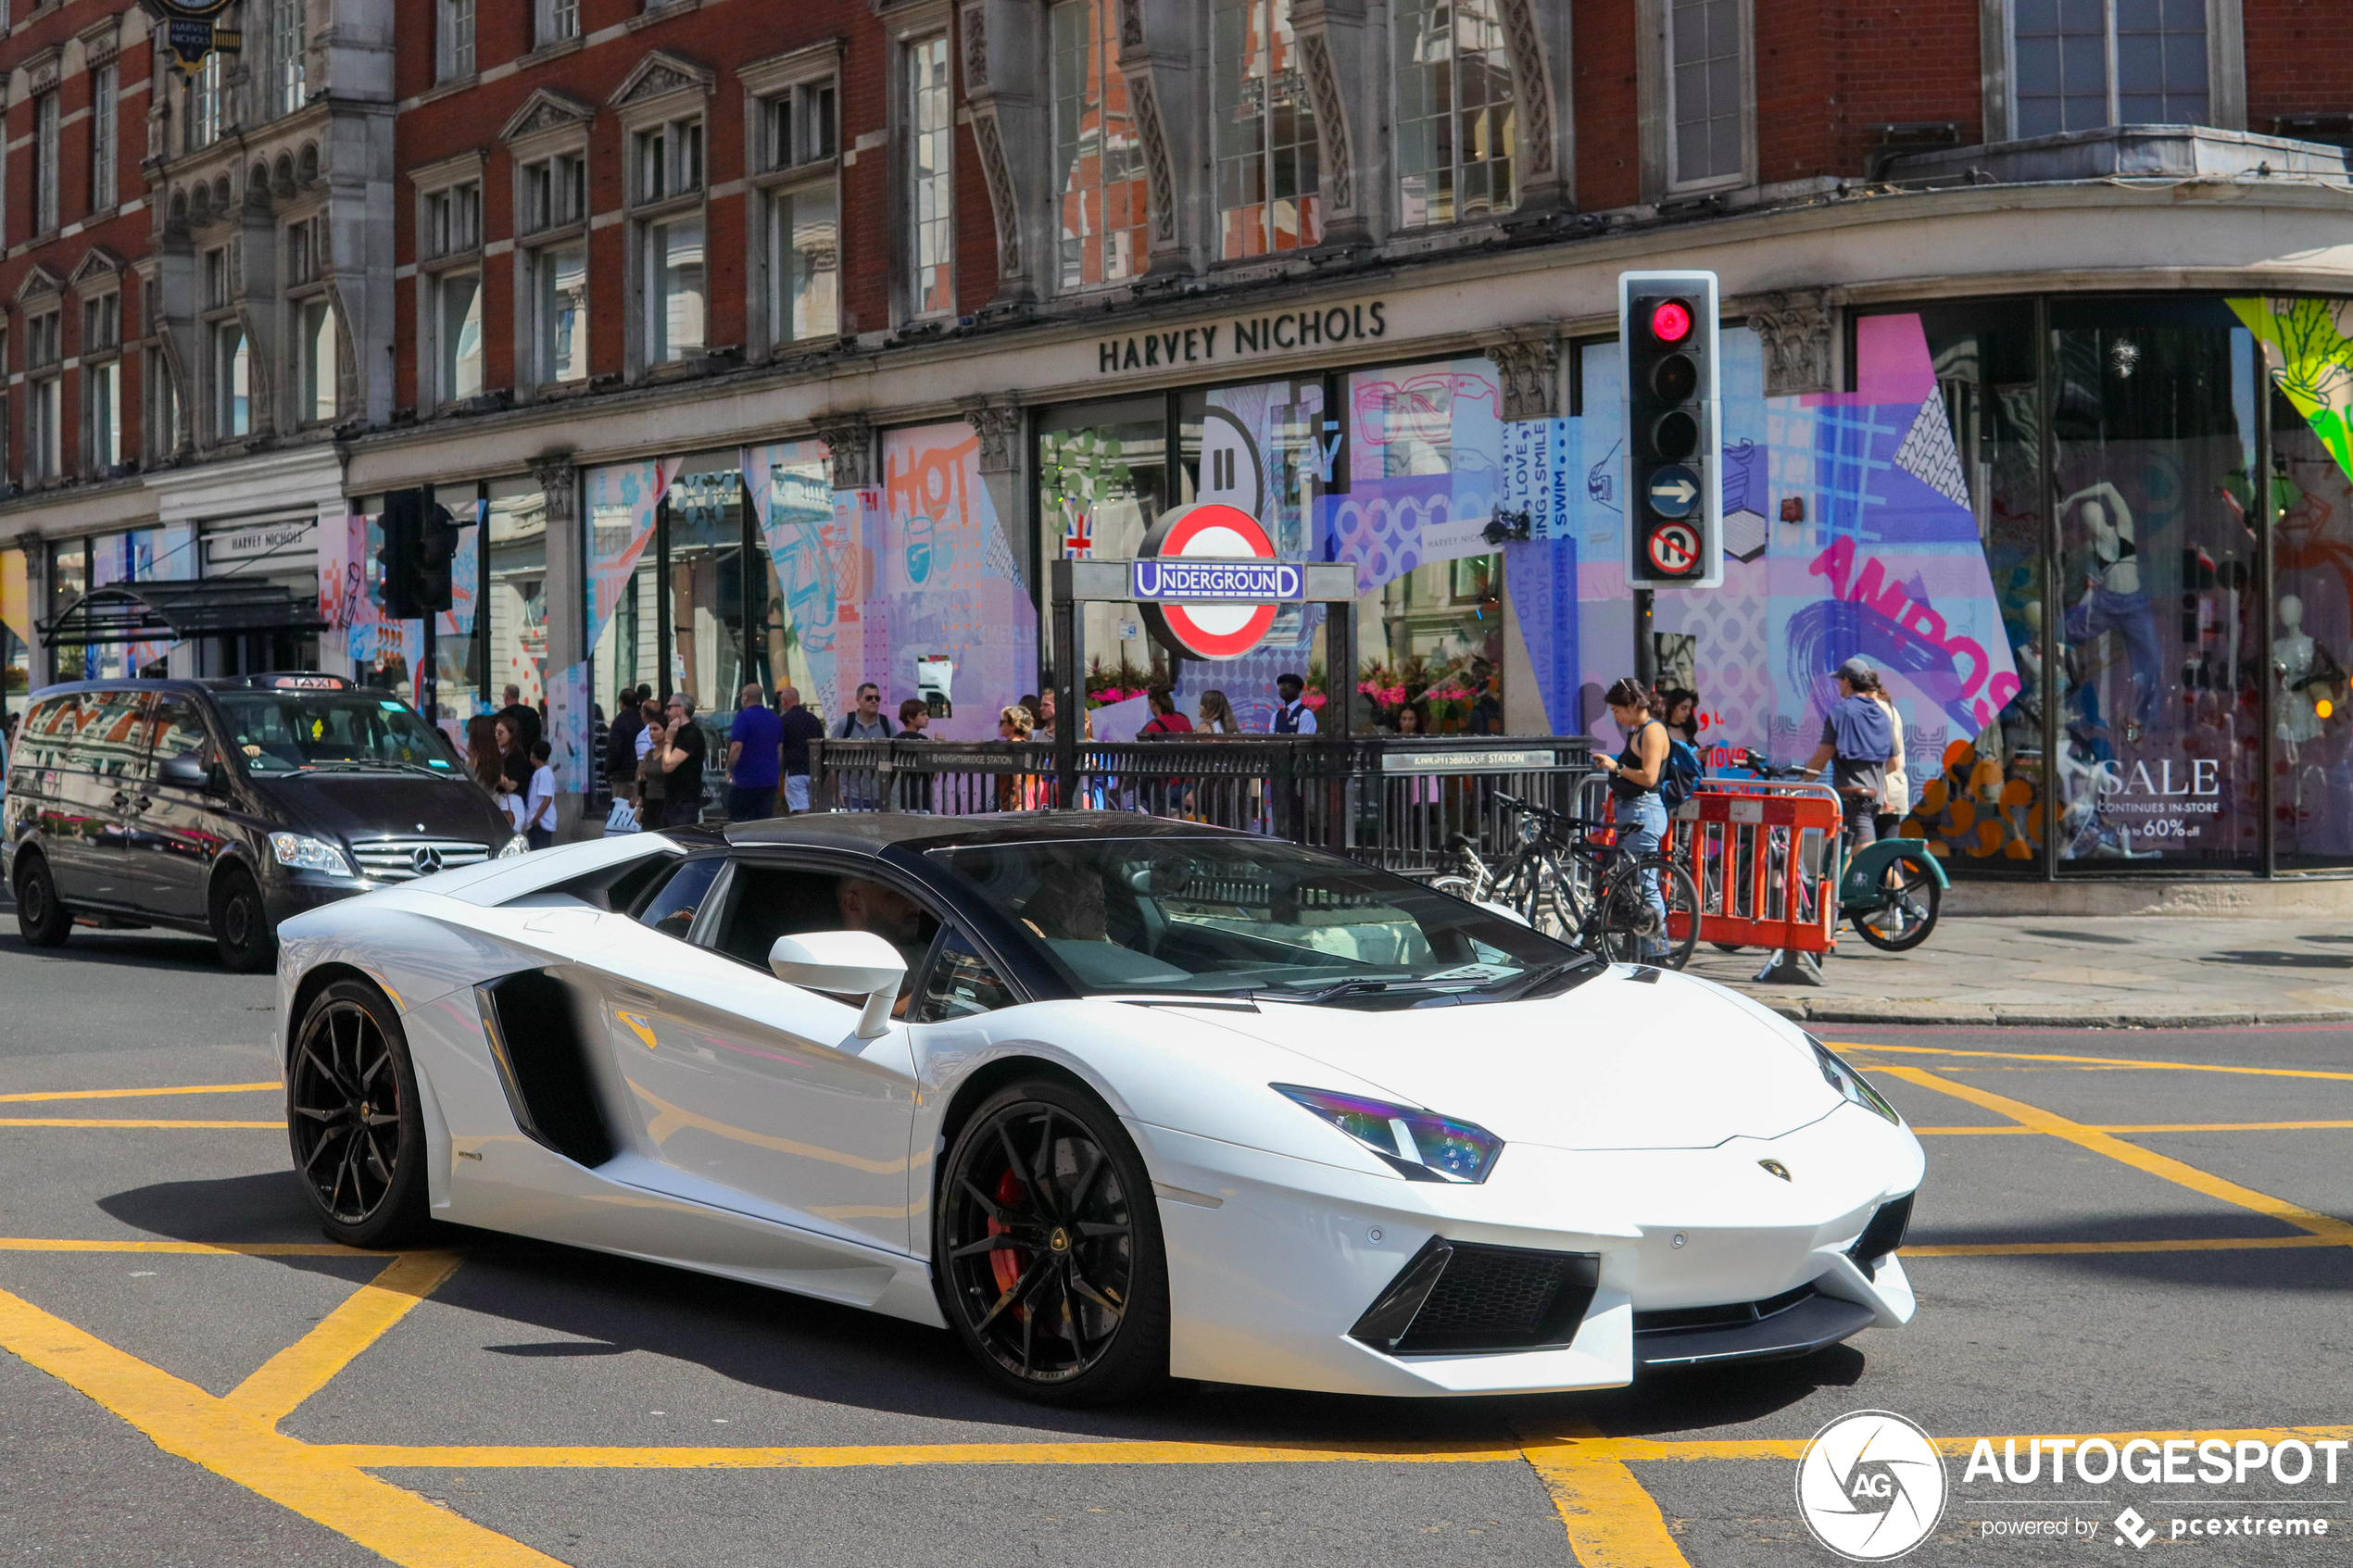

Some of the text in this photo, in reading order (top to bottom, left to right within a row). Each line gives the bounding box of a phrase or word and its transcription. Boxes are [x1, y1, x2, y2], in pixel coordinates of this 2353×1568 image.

[171, 22, 210, 33] HARVEY
[171, 33, 210, 44] NICHOLS
[1099, 301, 1386, 372] HARVEY NICHOLS
[887, 434, 979, 526] HOT
[232, 531, 302, 550] HARVEY NICHOLS
[1428, 533, 1482, 548] HARVEY NICH
[1137, 563, 1299, 597] UNDERGROUND
[291, 677, 332, 687] TAXI
[938, 754, 1013, 765] KNIGHTSBRIDGE STATION
[1415, 753, 1524, 765] KNIGHTSBRIDGE STATION
[2098, 759, 2220, 796] SALE
[2097, 802, 2220, 813] CONTINUES IN-STORE
[2144, 819, 2185, 837] 60%
[2186, 826, 2200, 836] off
